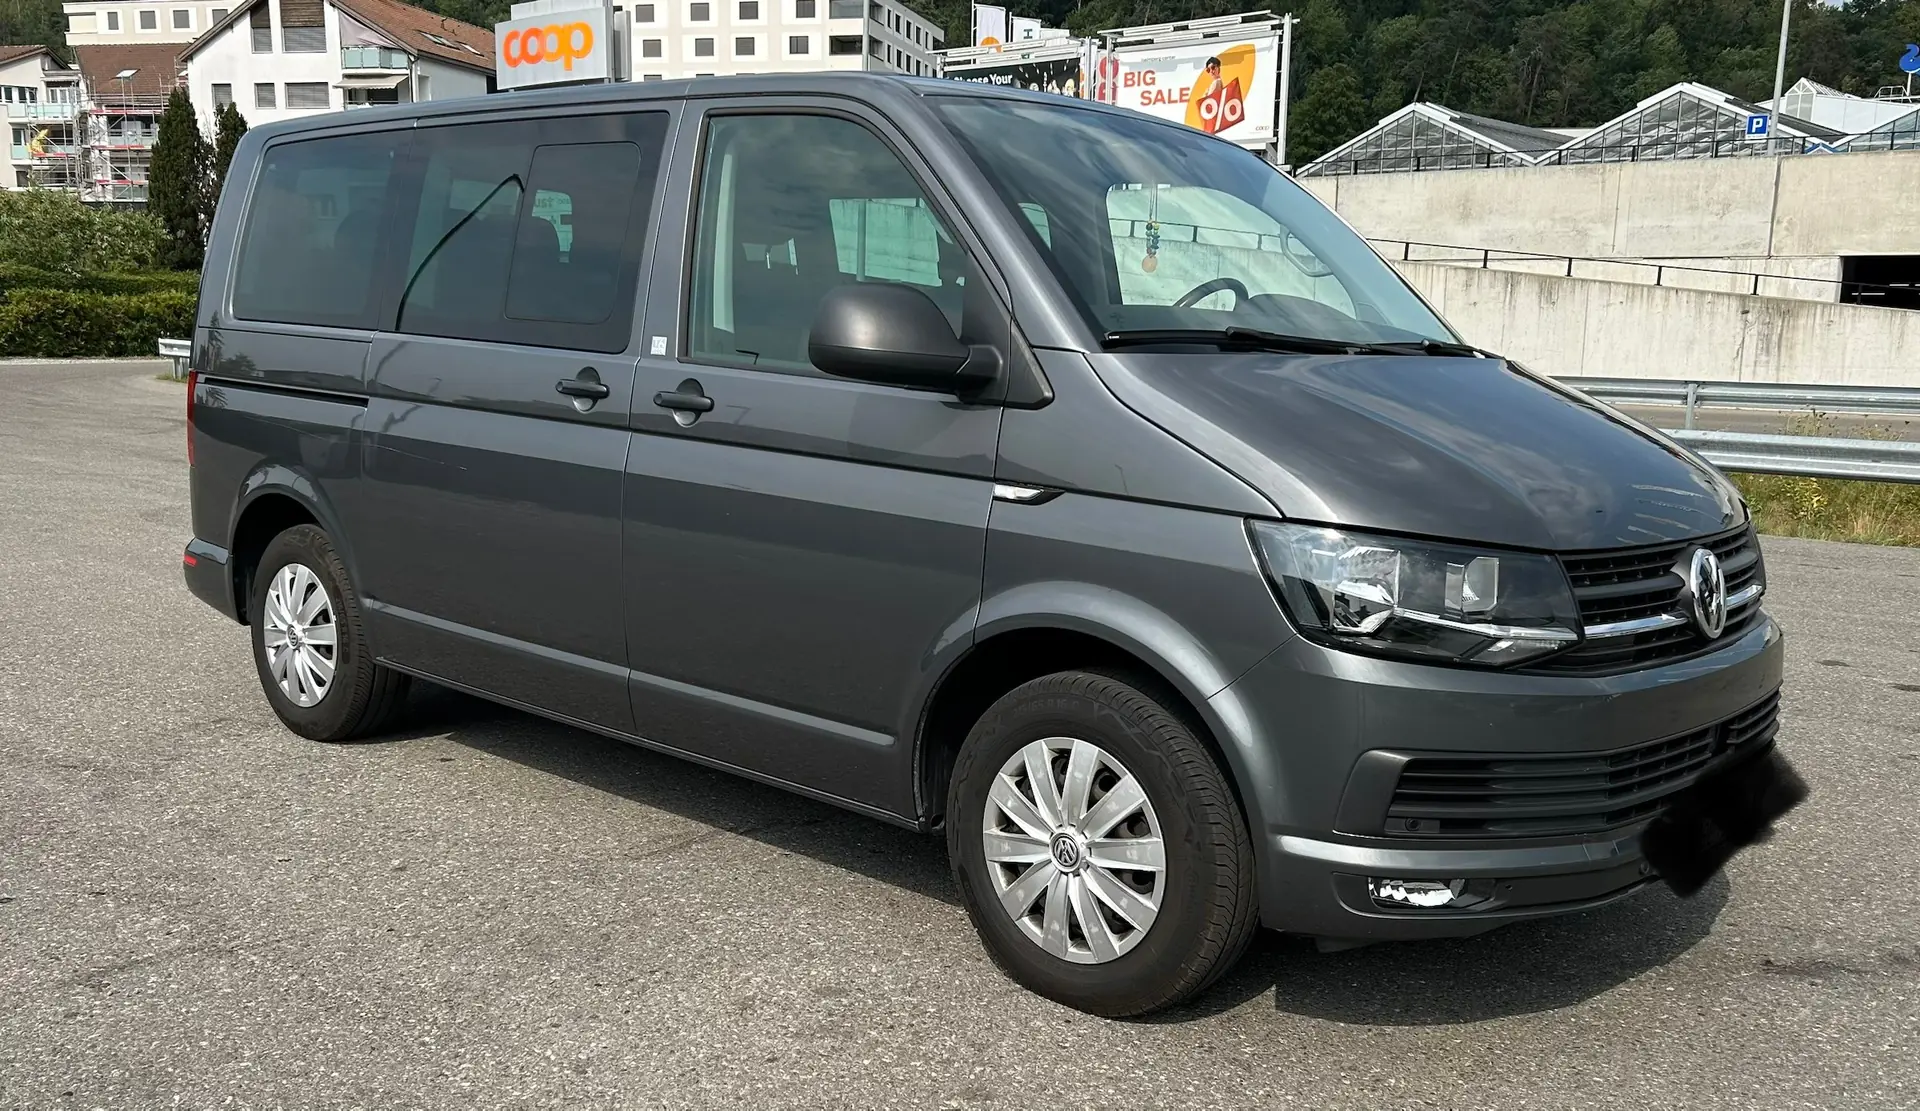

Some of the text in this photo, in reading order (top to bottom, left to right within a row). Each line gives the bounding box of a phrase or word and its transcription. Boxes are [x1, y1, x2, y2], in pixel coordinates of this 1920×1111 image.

[503, 21, 594, 71] coop
[989, 73, 1013, 85] Your
[1123, 70, 1156, 88] BIG
[1140, 87, 1190, 106] SALE
[1752, 118, 1763, 133] P
